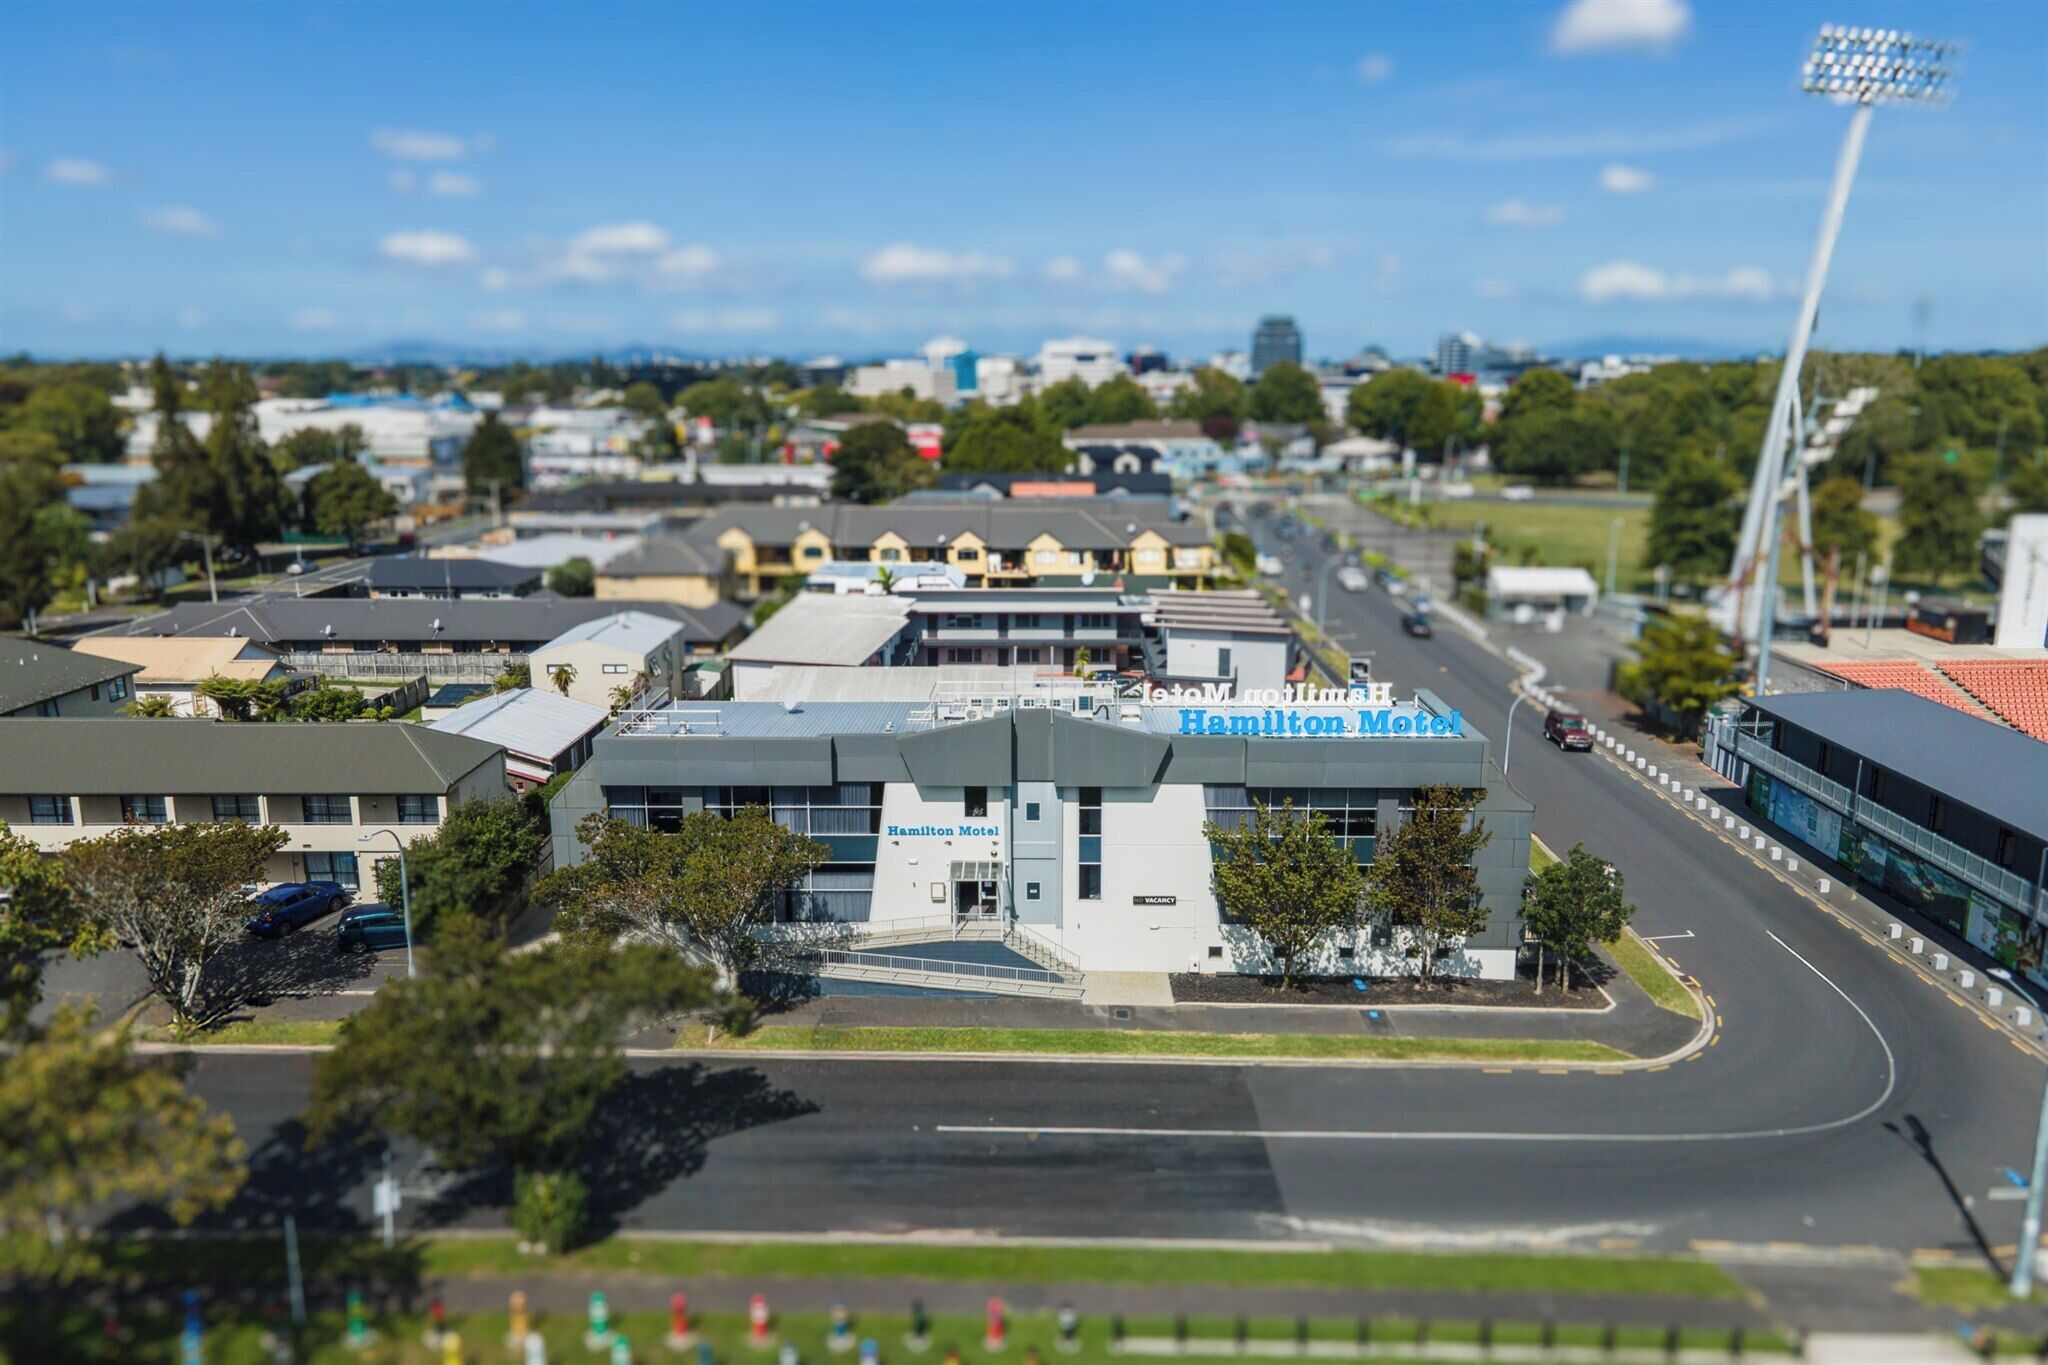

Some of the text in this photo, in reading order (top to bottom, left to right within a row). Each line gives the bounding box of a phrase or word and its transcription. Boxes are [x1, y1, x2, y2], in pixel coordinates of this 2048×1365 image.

[1179, 709, 1462, 735] Hamilton Motel
[888, 825, 1000, 836] Hamilton Motel
